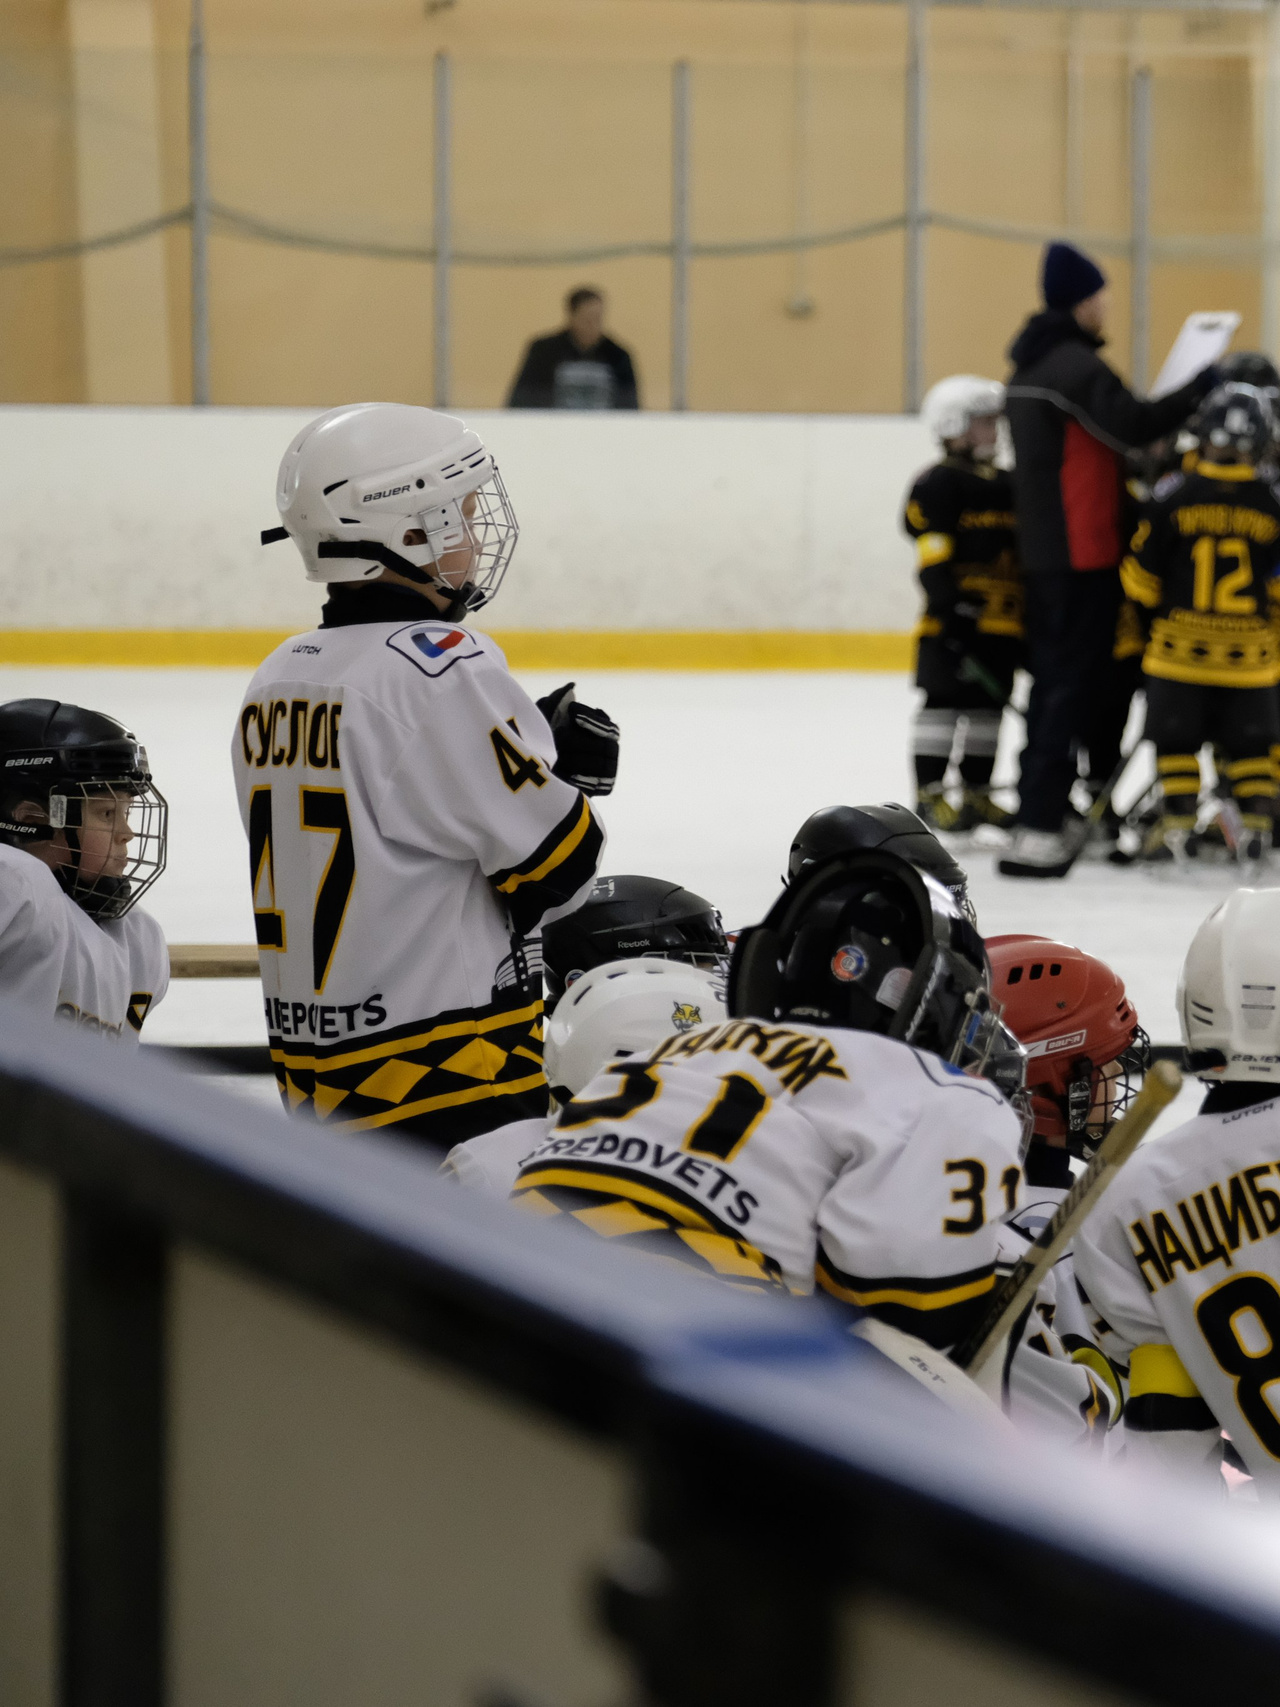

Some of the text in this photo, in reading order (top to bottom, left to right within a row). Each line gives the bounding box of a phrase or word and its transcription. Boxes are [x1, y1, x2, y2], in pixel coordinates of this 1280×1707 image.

[362, 484, 411, 503] BAUER
[1191, 536, 1257, 614] 12
[5, 757, 54, 768] BAUER
[249, 783, 356, 996] 47
[617, 938, 651, 949] Reebok
[1222, 1103, 1274, 1124] LUTCH
[942, 1156, 1022, 1237] 31
